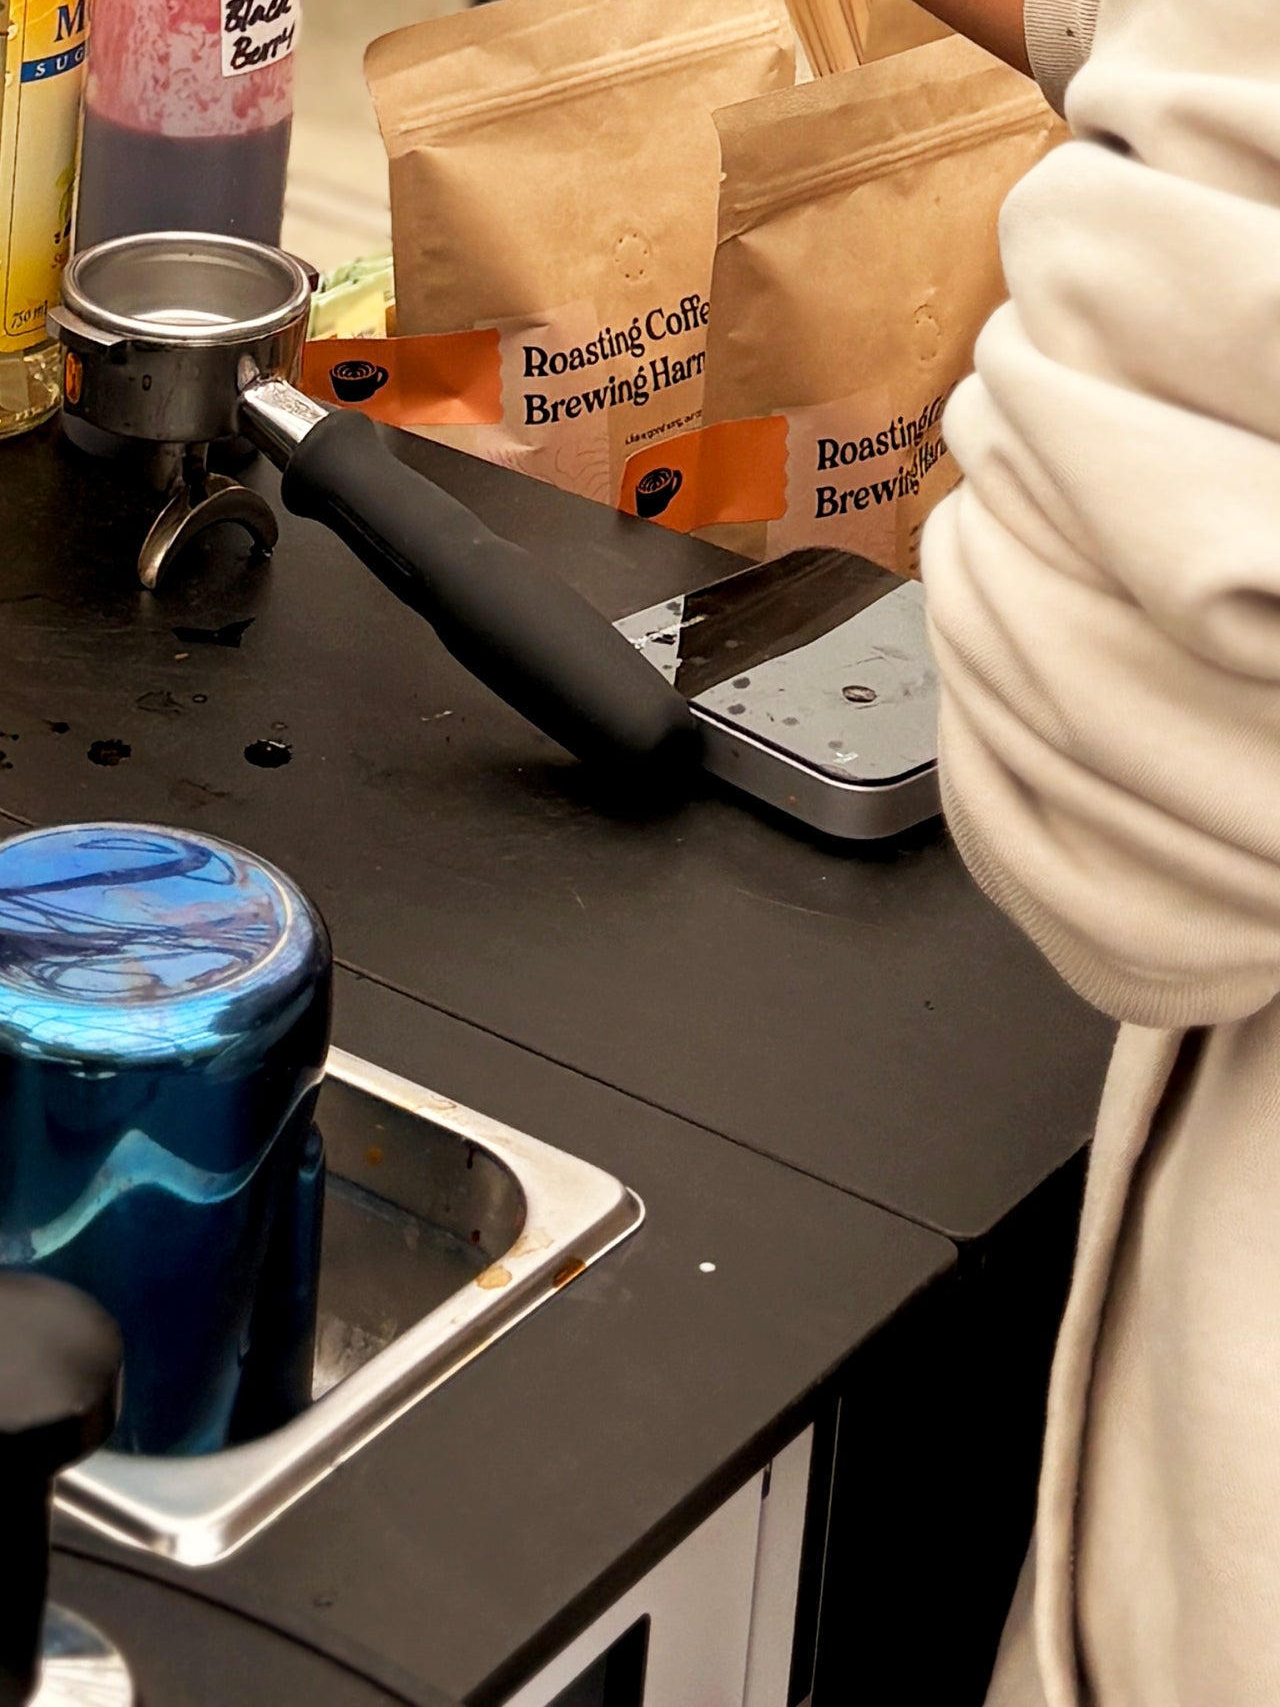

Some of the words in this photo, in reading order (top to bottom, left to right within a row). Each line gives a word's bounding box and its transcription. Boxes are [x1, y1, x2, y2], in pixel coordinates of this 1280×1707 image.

[230, 19, 296, 71] Berry
[11, 308, 31, 329] 750
[523, 318, 645, 378] Roasting
[645, 294, 710, 341] Coffe
[524, 366, 650, 426] Brewing
[817, 405, 928, 471] Roasting
[815, 455, 920, 519] Brewing
